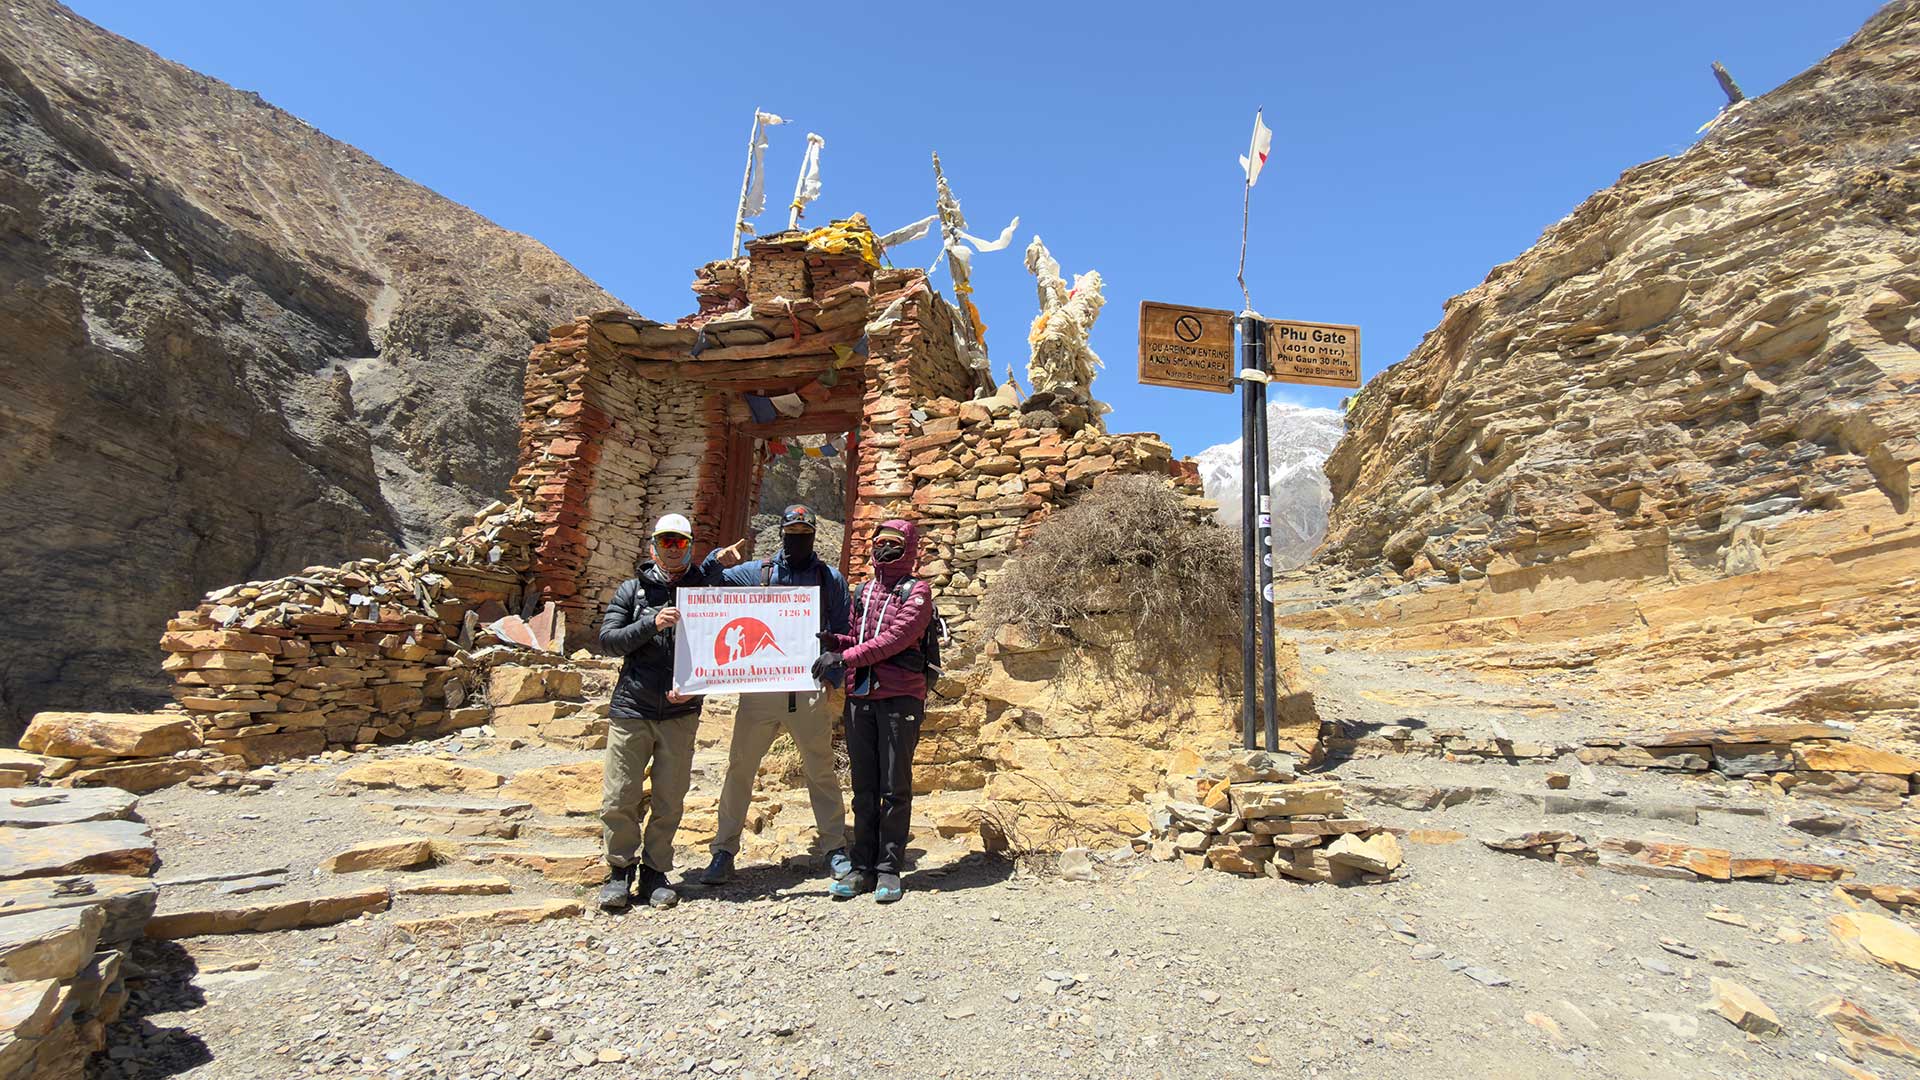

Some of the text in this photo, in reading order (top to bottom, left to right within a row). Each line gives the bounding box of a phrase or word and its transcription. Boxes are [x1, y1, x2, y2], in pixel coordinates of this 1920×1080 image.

[1280, 327, 1346, 344] Phu Gate
[1148, 343, 1230, 360] YOU ARE NOW ENTRING
[1282, 344, 1344, 357] (4010 Mtr.)
[1173, 357, 1206, 369] SMOKING
[1207, 361, 1226, 372] AREA
[1277, 353, 1350, 367] Phu Gaun 30 Min.
[1294, 365, 1314, 374] Narpa
[1315, 367, 1337, 376] Bhumi
[688, 593, 811, 605] HIMLUNG HIMAL EXPEDITION 2026
[778, 609, 811, 617] 7126 M
[695, 664, 806, 678] OUTWARD ADVENTURE
